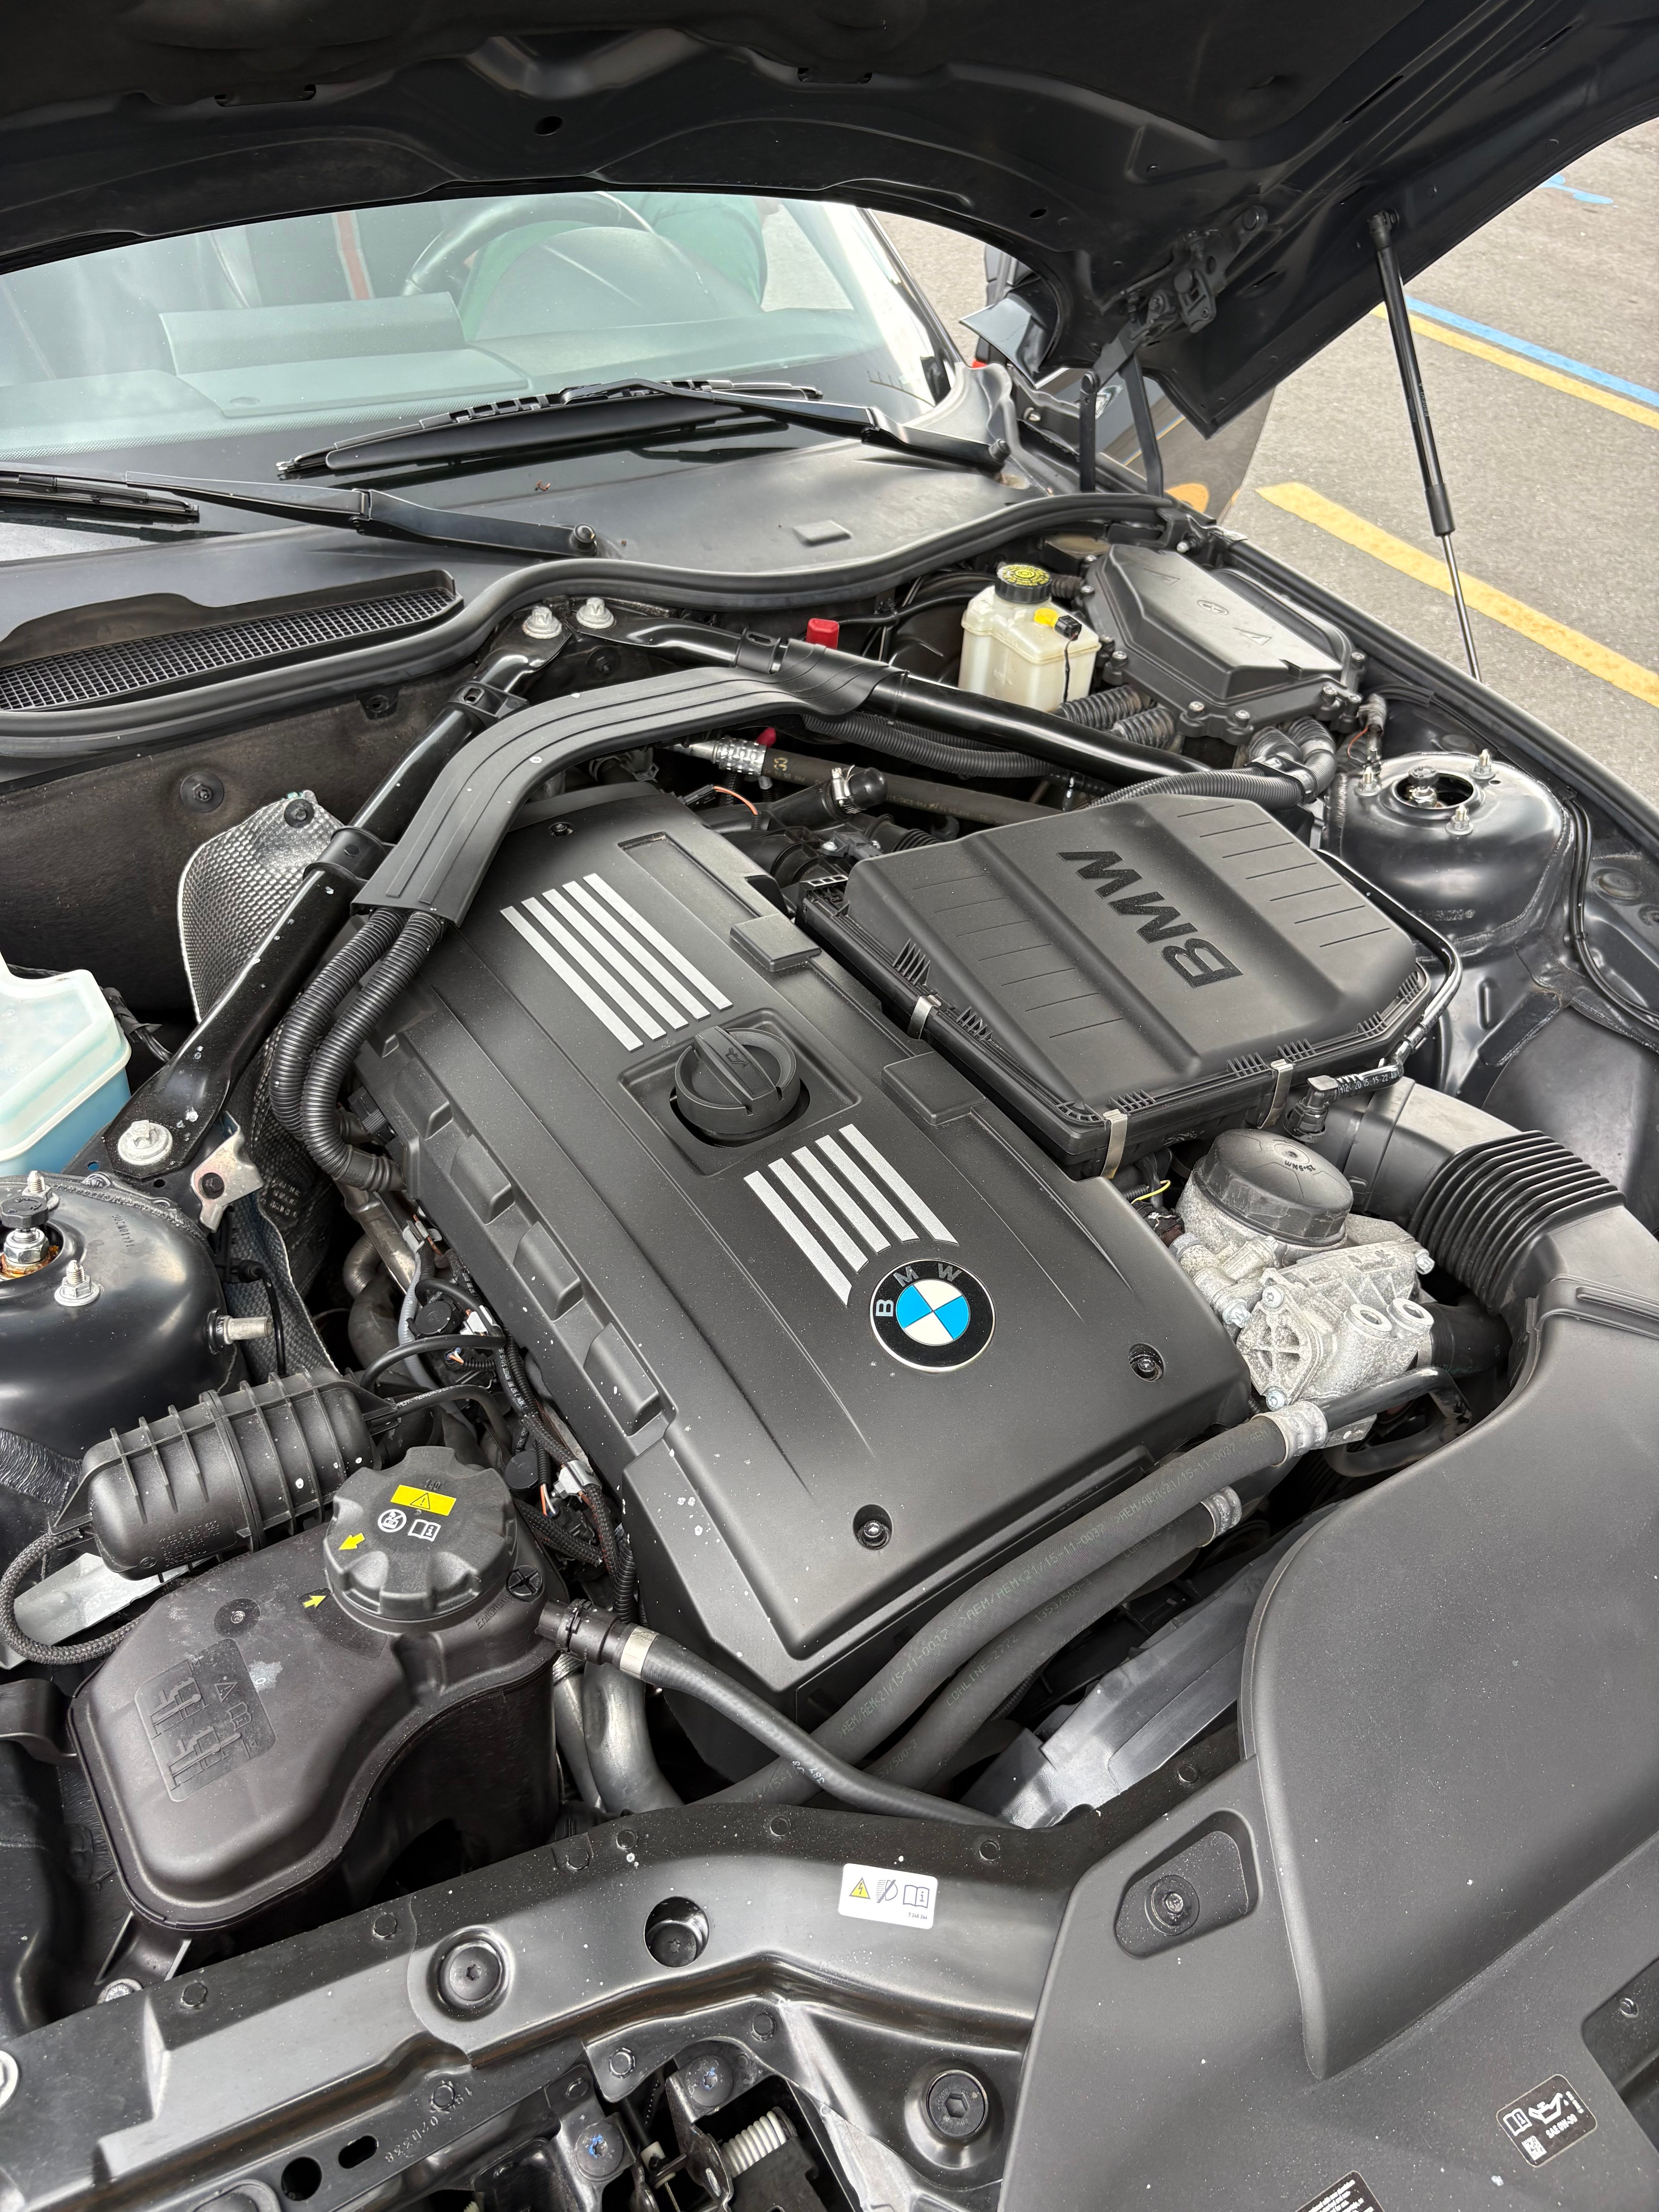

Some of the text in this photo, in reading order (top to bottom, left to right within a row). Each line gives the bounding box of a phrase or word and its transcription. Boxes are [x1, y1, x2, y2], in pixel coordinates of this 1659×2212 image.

[1056, 851, 1243, 989] BMW
[876, 1263, 962, 1317] BMW
[1545, 2112, 1578, 2139] SAE 0W-30
